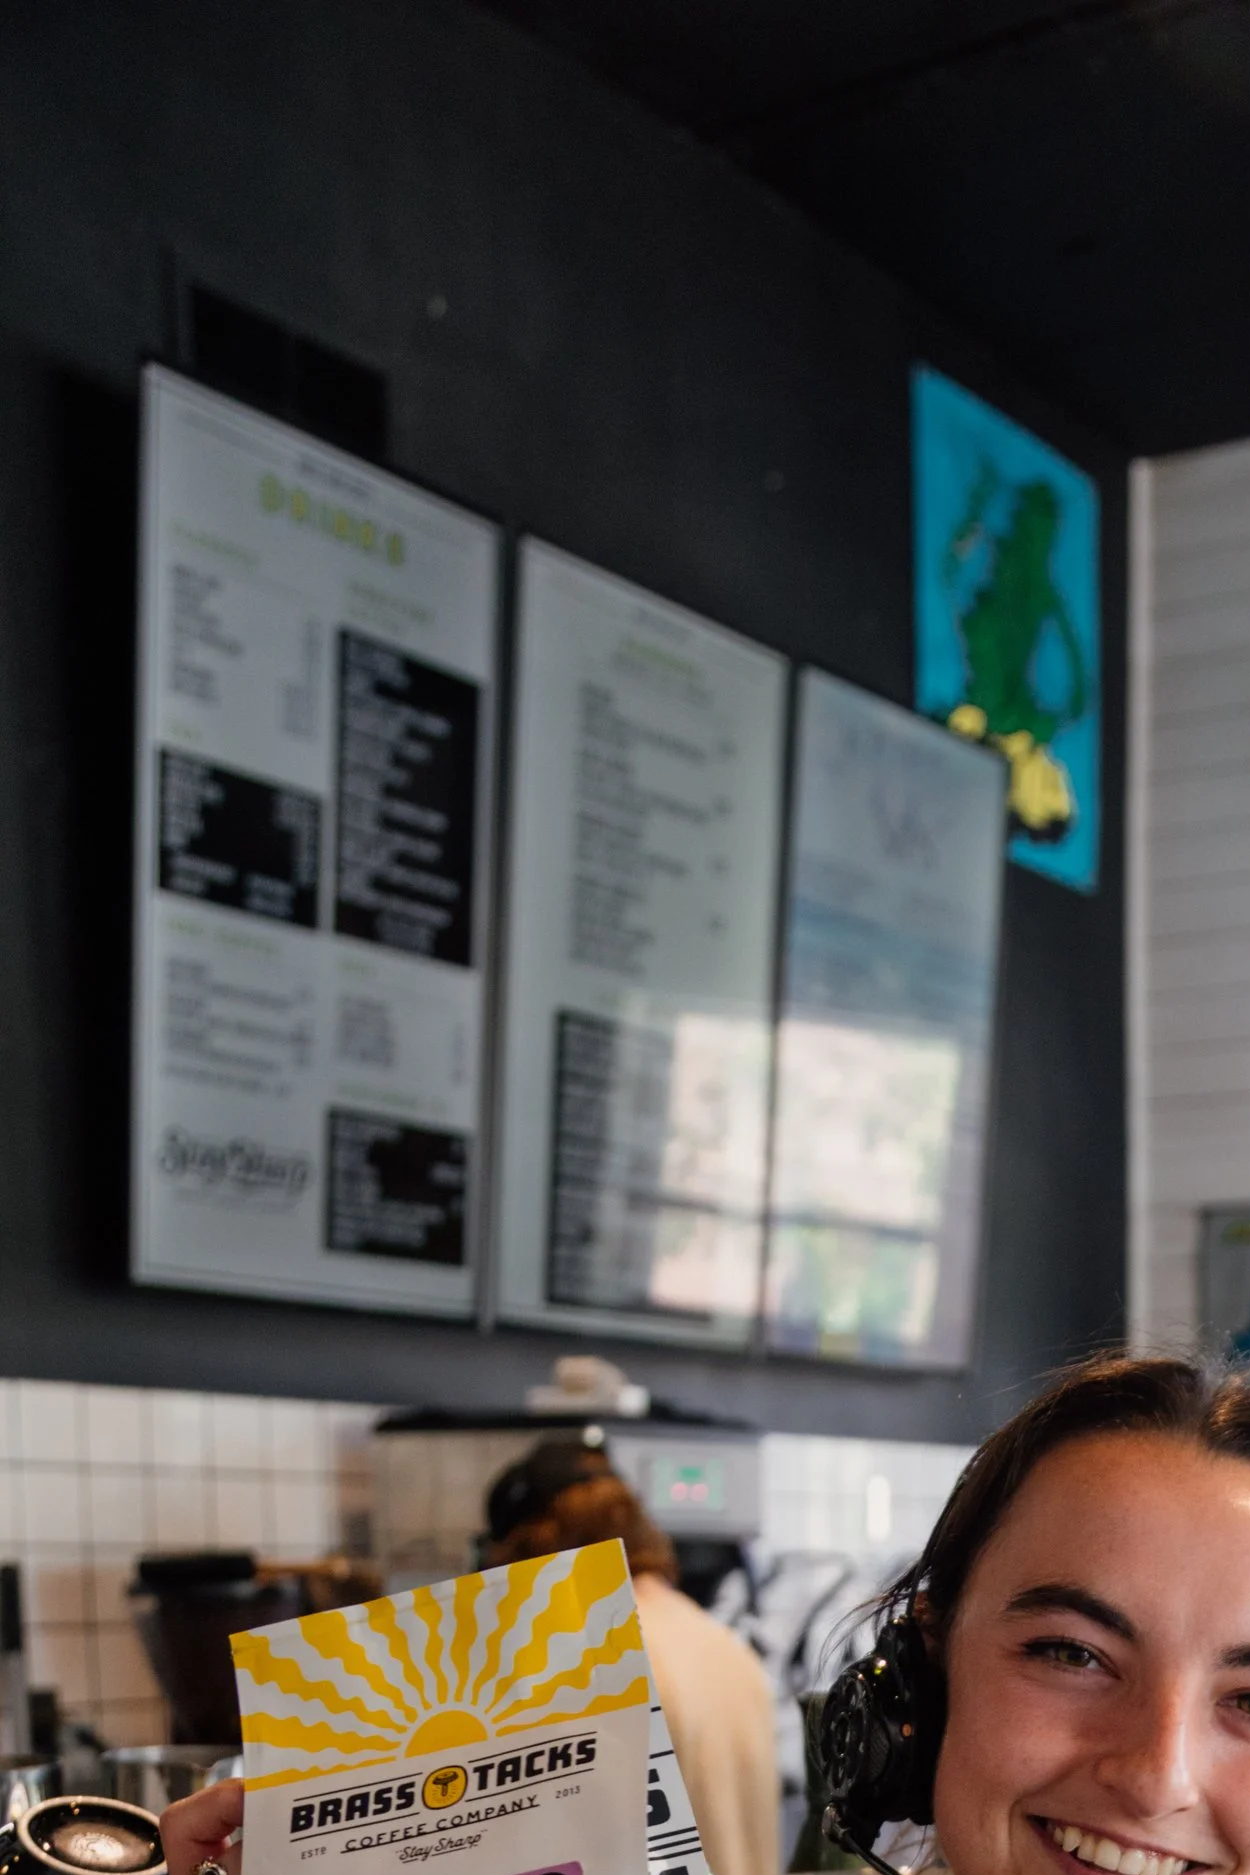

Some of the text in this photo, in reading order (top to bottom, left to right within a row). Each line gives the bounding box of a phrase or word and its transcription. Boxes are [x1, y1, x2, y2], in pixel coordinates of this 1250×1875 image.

[290, 1738, 597, 1833] BRASS TACKS
[344, 1823, 427, 1852] COFFEE
[436, 1795, 539, 1831] COMPANY
[555, 1785, 581, 1799] 2013
